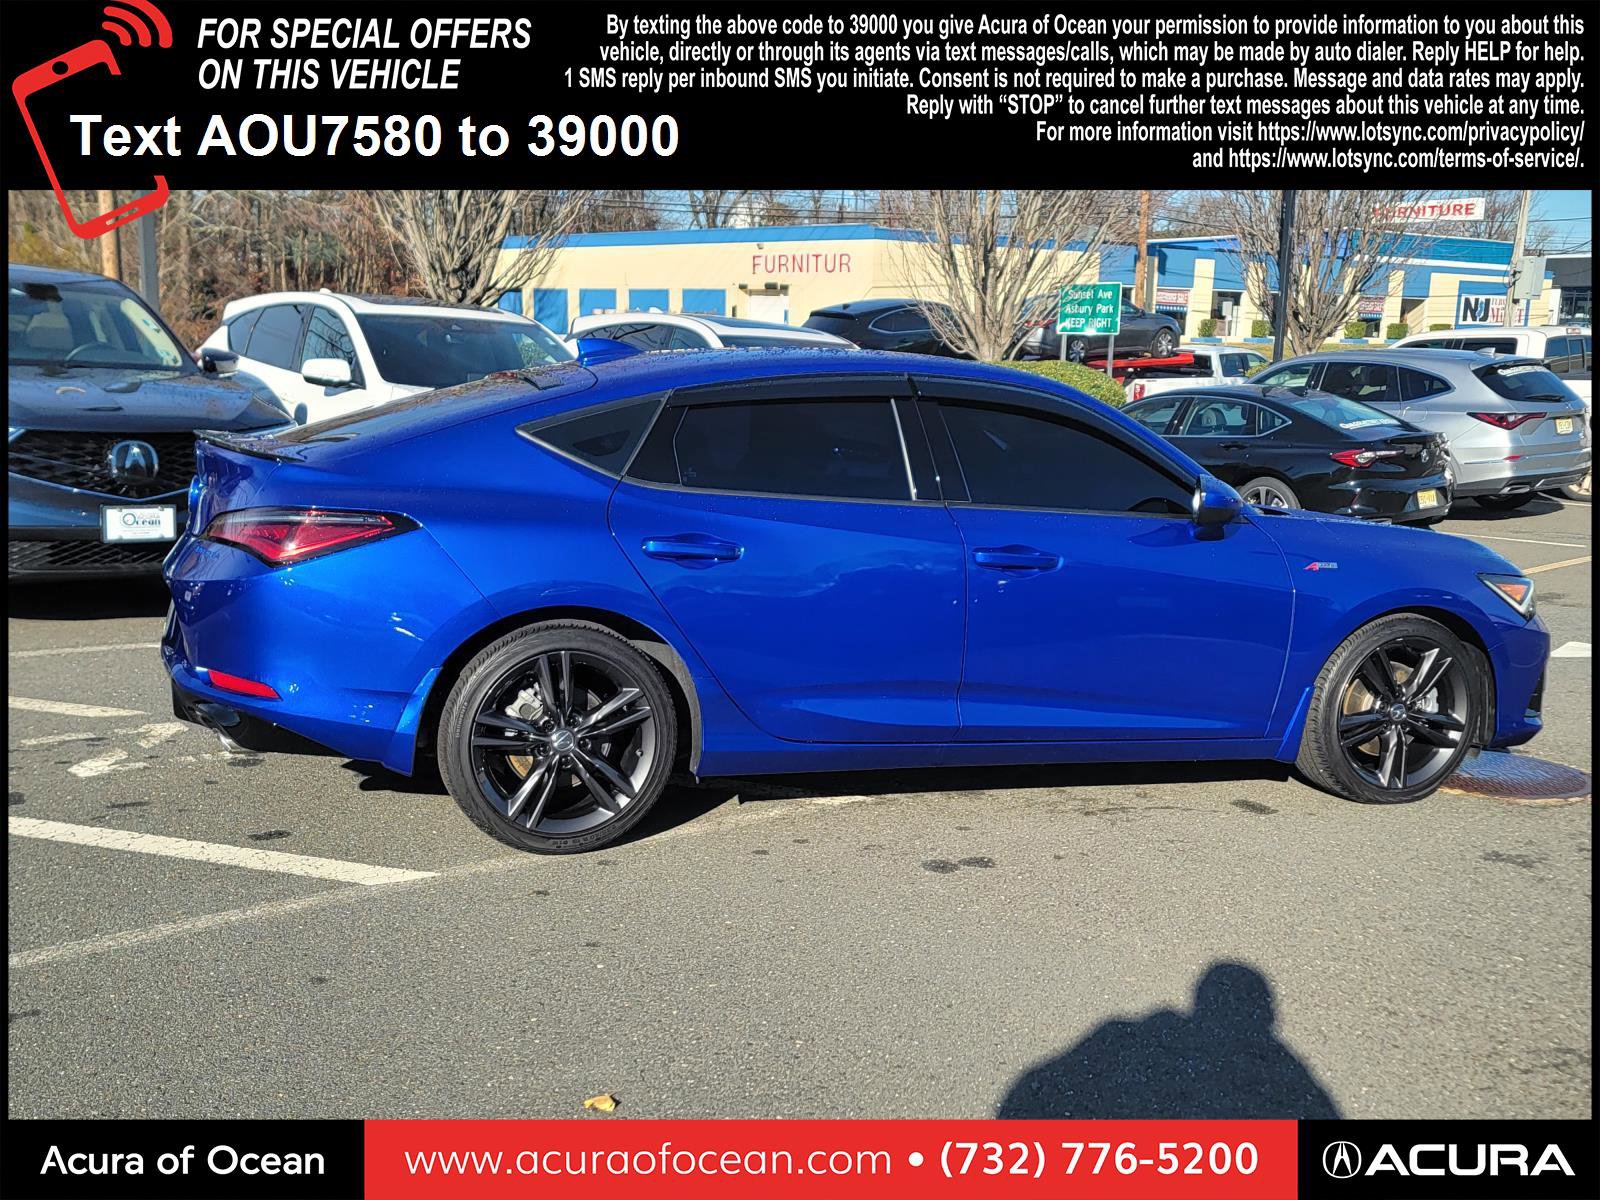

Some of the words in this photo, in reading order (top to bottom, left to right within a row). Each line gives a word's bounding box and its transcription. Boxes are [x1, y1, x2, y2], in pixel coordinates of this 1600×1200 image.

[752, 253, 851, 274] FURNITUR
[1068, 289, 1094, 300] Sunset
[1097, 289, 1113, 299] Ave
[1066, 304, 1093, 316] Asbury
[1096, 303, 1114, 314] Park
[1066, 318, 1086, 329] KEEP
[1088, 317, 1112, 328] RIGHT
[122, 512, 161, 527] Ocean
